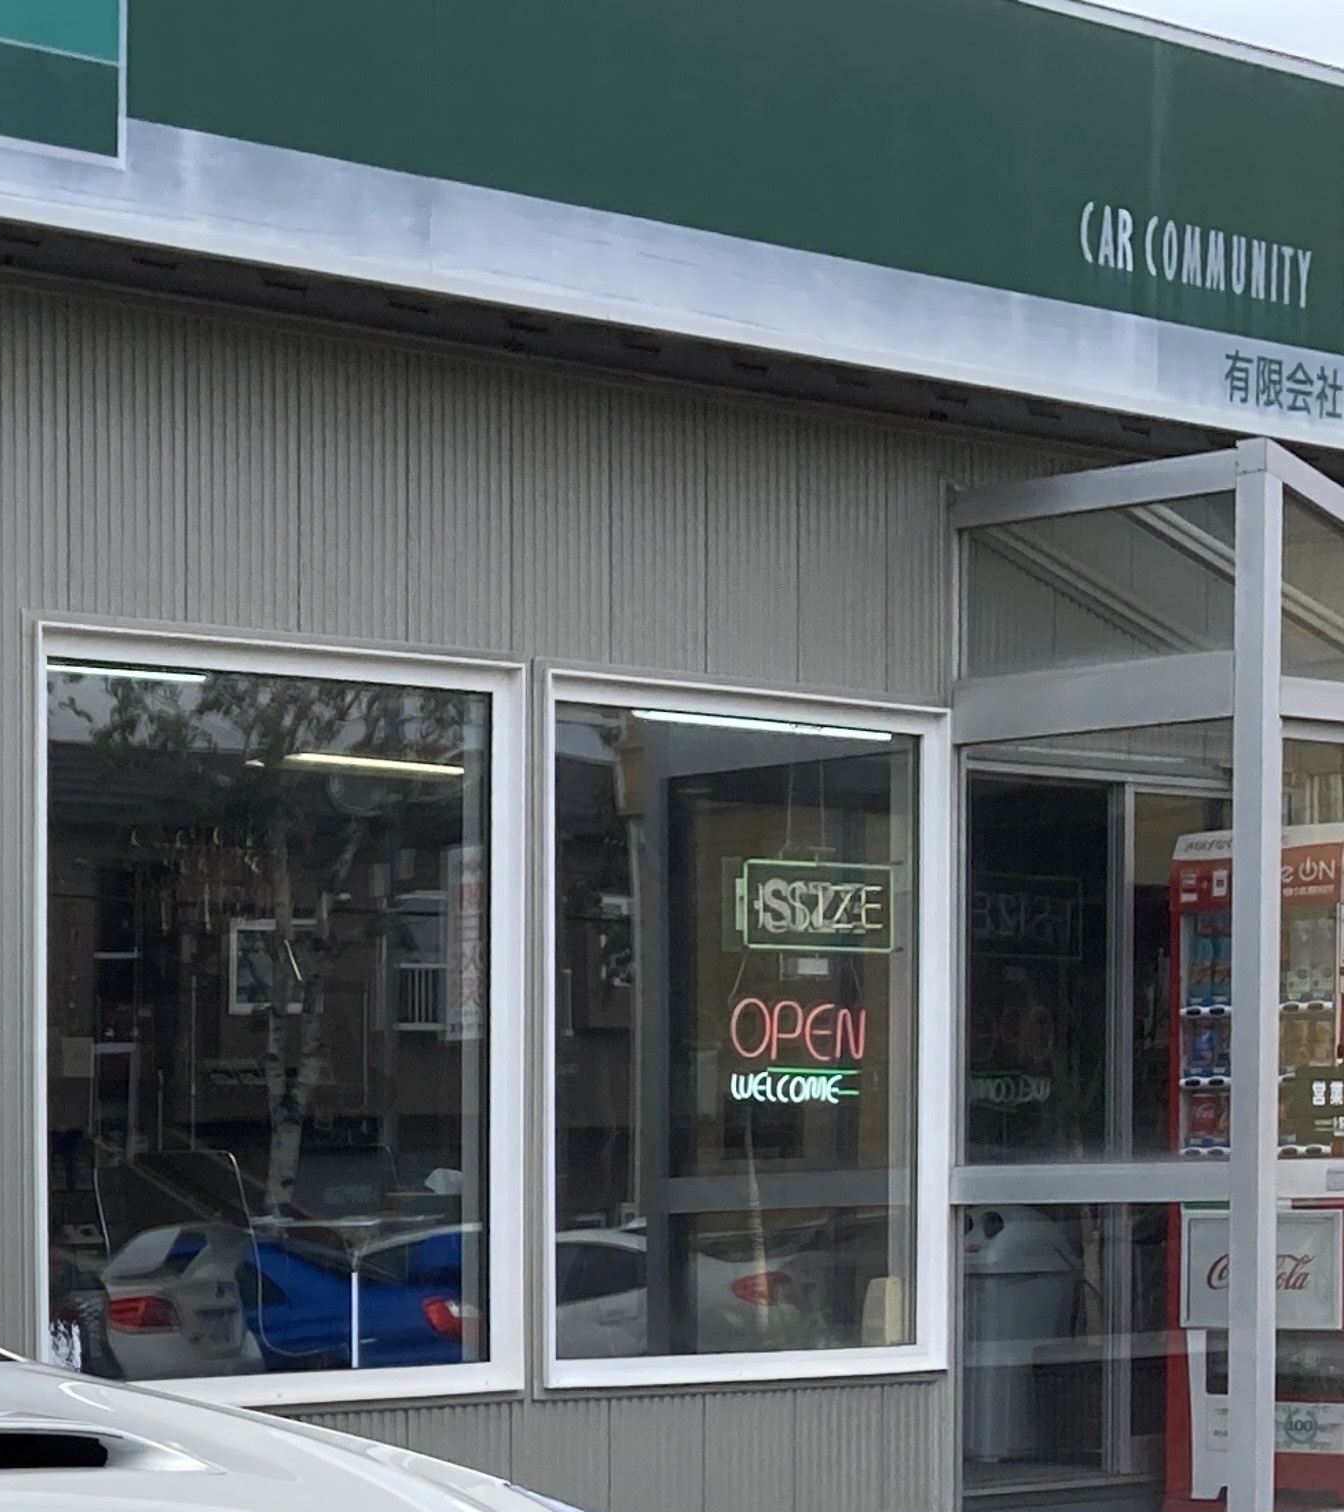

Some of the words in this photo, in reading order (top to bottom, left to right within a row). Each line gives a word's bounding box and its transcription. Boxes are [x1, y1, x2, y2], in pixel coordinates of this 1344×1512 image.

[1080, 202, 1133, 272] CAR
[1145, 215, 1312, 308] COMMUNITY
[1224, 349, 1343, 419] 有限会社
[730, 997, 866, 1061] OPEN
[730, 1071, 843, 1103] WELCOME
